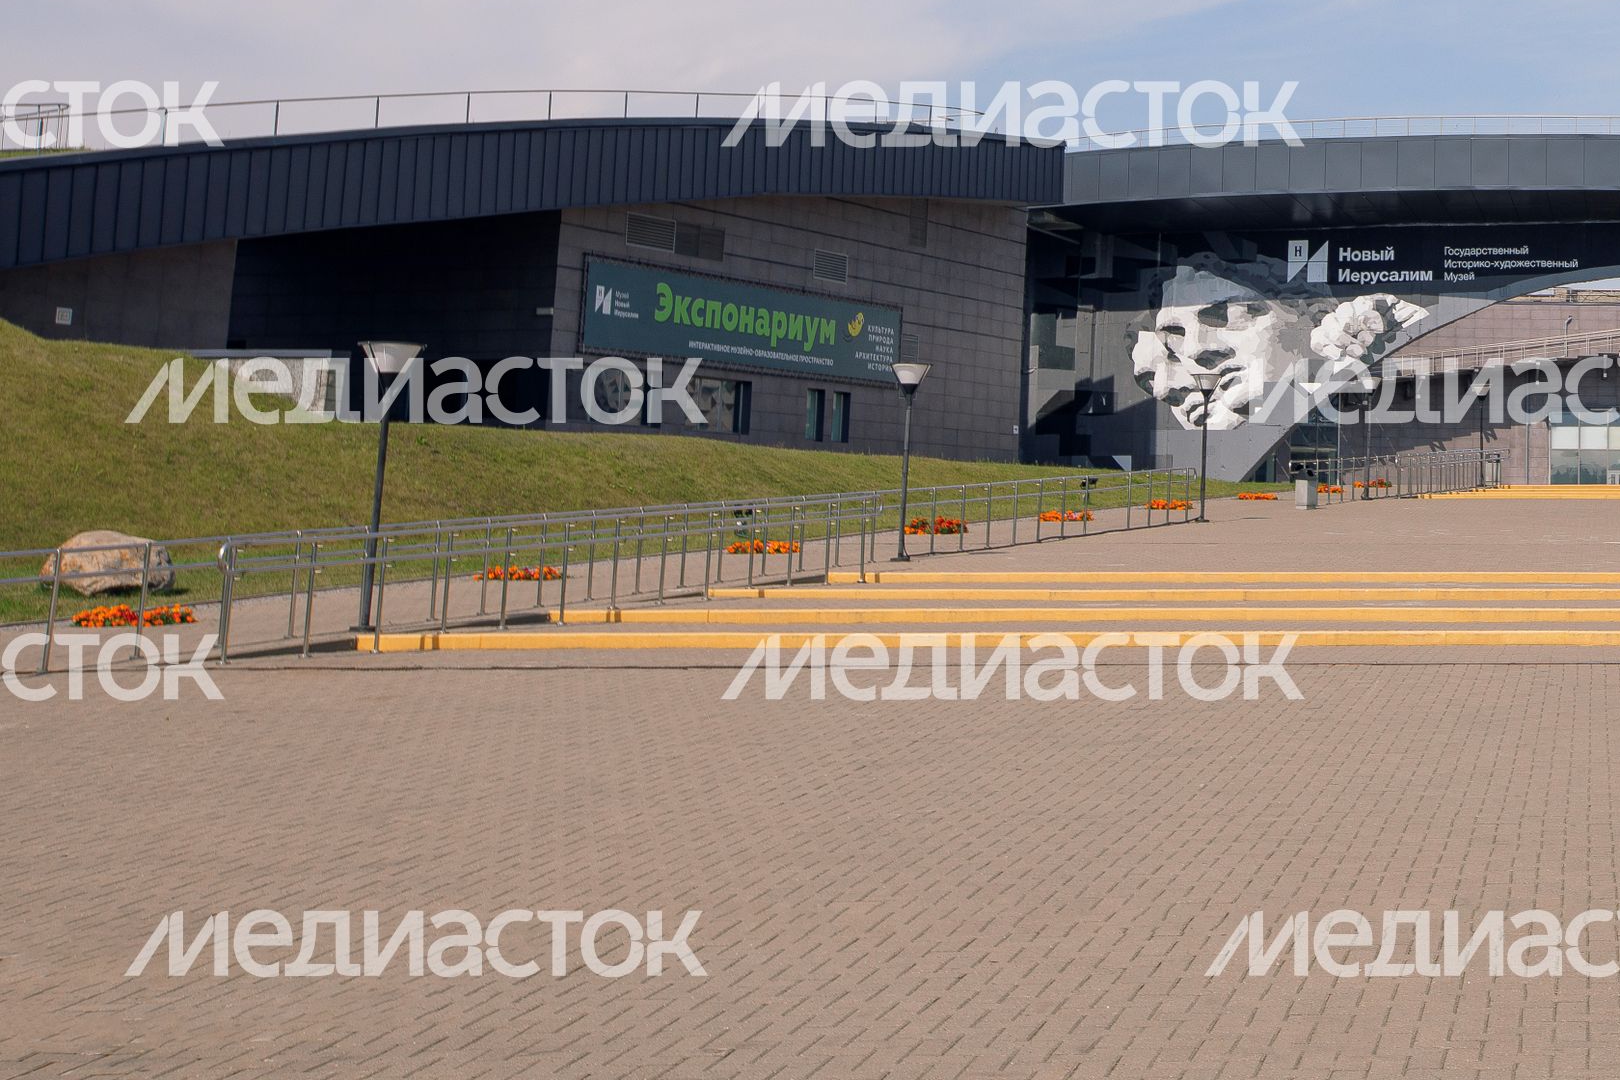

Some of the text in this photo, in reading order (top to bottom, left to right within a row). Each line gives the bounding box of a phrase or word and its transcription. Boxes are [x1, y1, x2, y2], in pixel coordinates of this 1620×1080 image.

[1338, 246, 1395, 262] Новый
[1444, 245, 1529, 258] Государственный
[1444, 258, 1579, 270] Историко-художественный
[1338, 268, 1433, 285] Иерусалим
[1443, 271, 1475, 284] Музей
[654, 282, 836, 352] Экспонариум
[867, 324, 895, 335] КУЛЬТУРА
[868, 333, 894, 345] ПРИРОДА
[688, 340, 731, 354] ИНТЕРАКТИВНОЕ
[799, 354, 834, 366] ПРОСТРАНСТВО
[855, 351, 893, 363] АРХИТЕКТУРА
